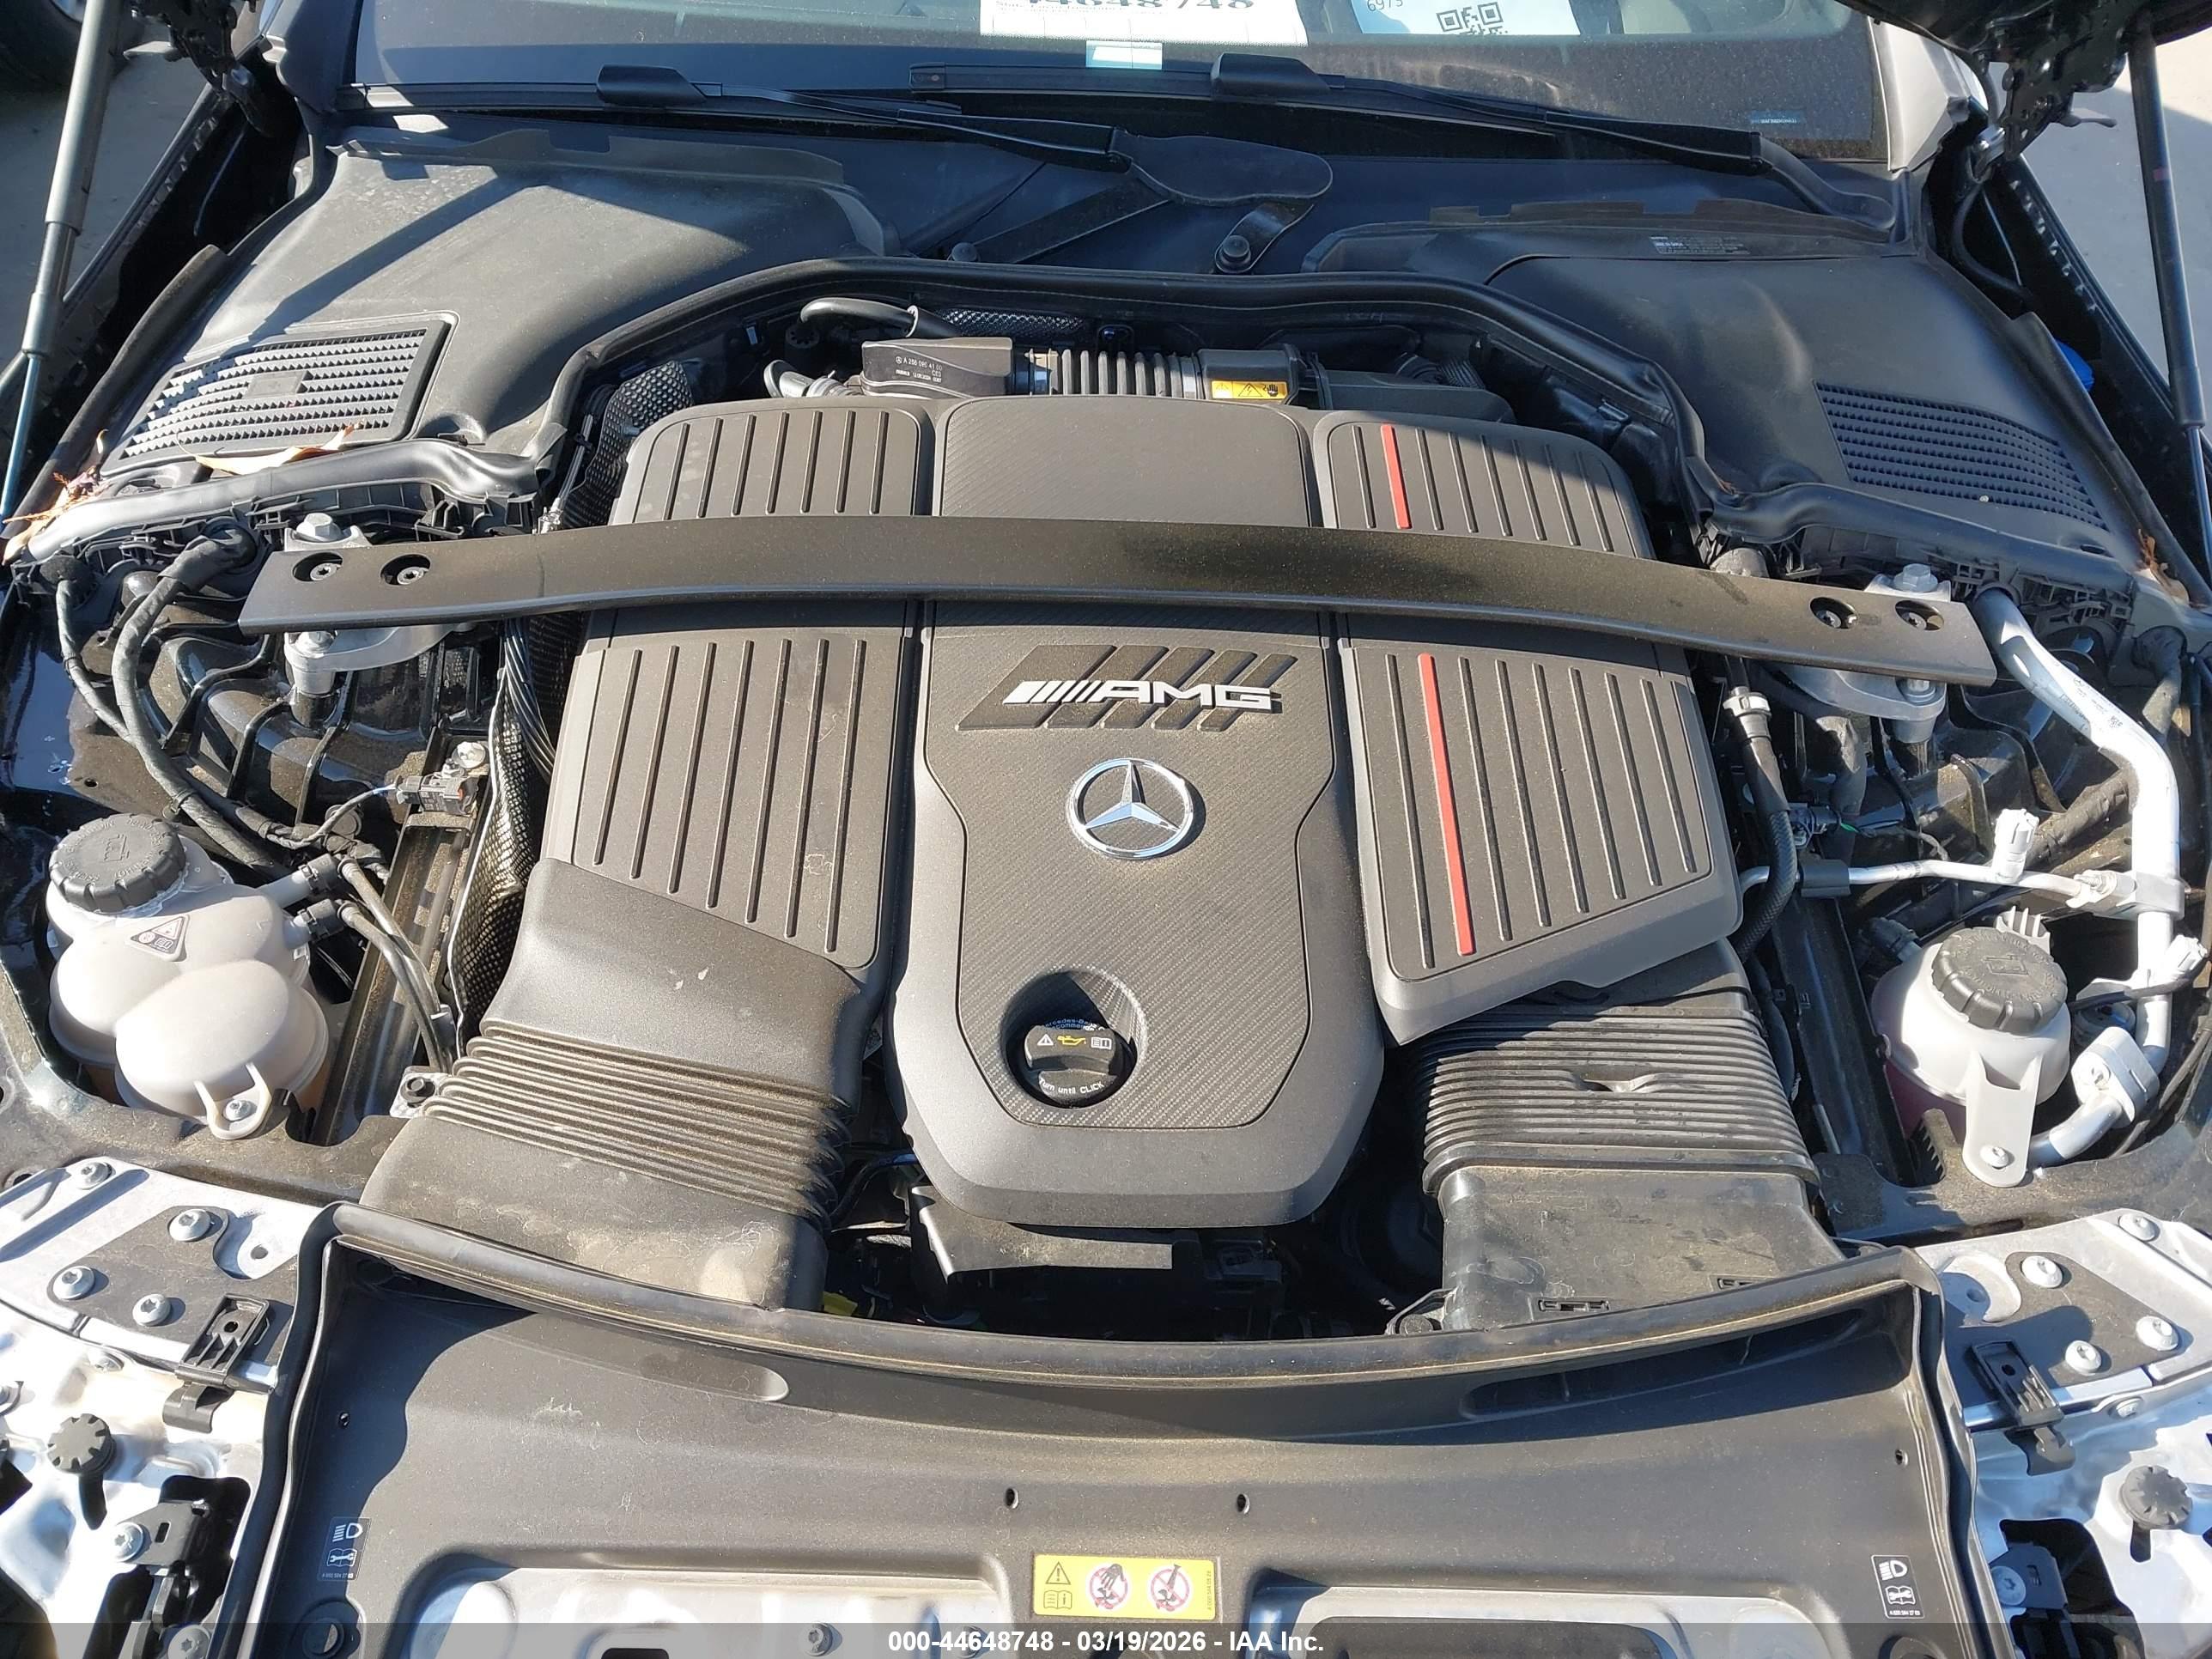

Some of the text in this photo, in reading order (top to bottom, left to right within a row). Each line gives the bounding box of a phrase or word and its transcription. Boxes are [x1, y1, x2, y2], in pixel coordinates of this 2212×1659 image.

[1089, 679, 1273, 710] AMG
[1045, 1018, 1097, 1029] ercedes-Benz
[1039, 1078, 1055, 1091] Turn
[1079, 1081, 1105, 1094] CLICK
